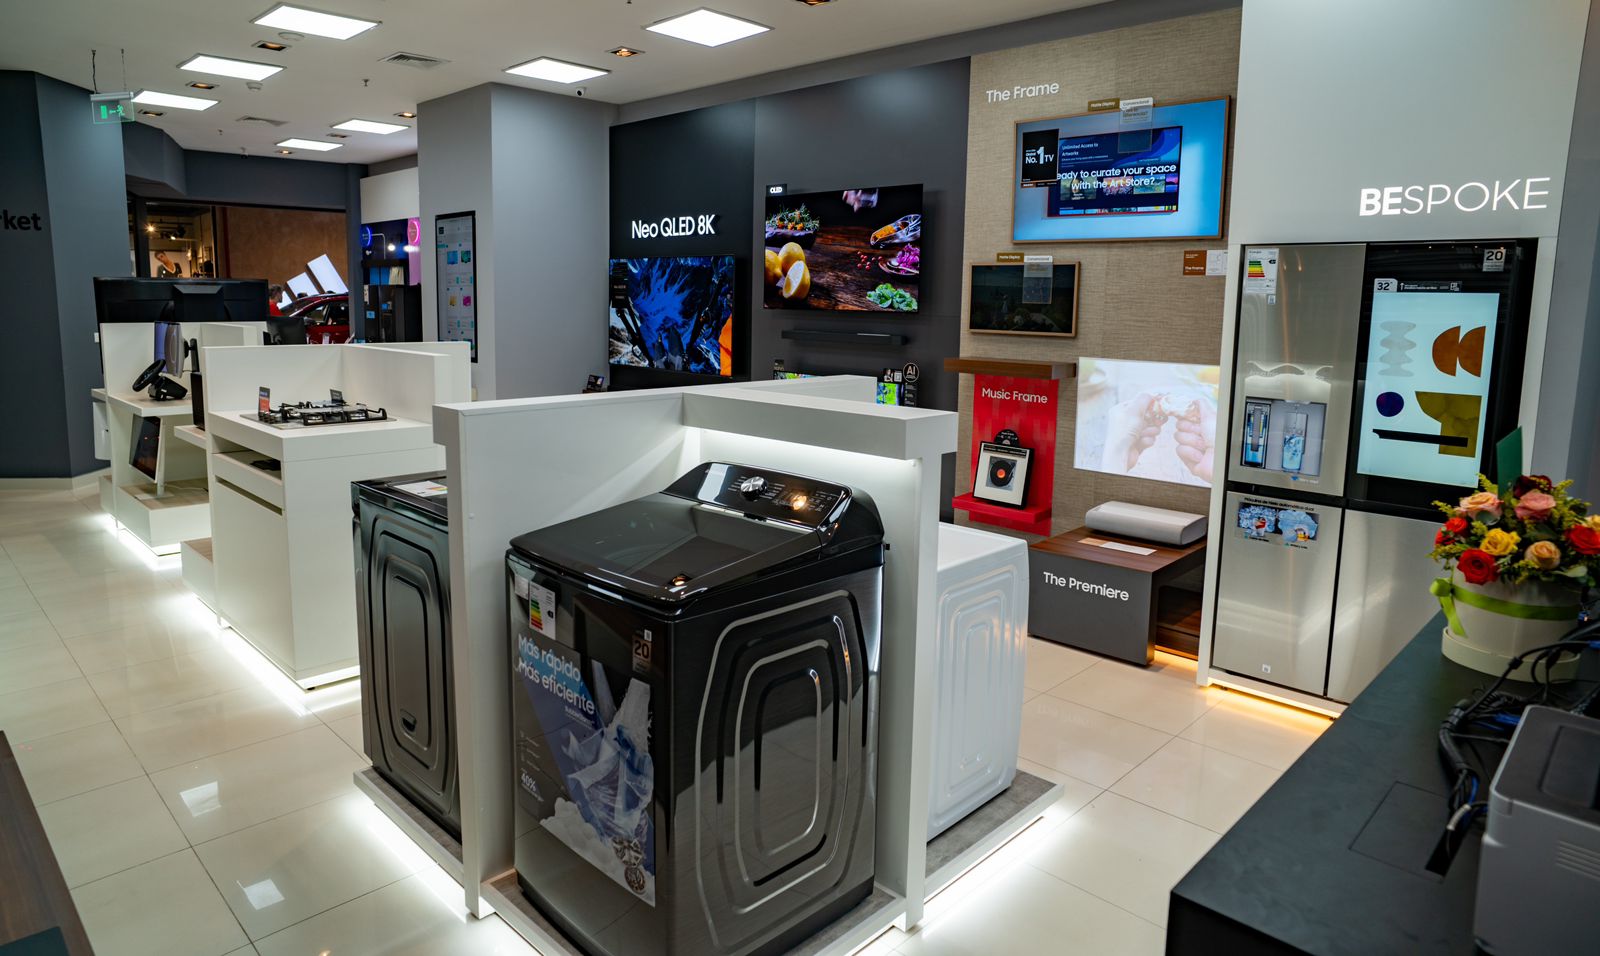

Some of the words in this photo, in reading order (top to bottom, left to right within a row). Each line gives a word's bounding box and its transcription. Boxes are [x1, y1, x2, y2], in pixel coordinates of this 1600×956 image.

[986, 89, 1011, 103] The
[1013, 82, 1060, 99] Frame
[1036, 146, 1045, 165] 1
[1044, 153, 1055, 162] TV
[1057, 170, 1078, 181] eady
[1080, 169, 1089, 178] to
[1090, 167, 1121, 178] curate
[1122, 166, 1144, 178] your
[1145, 164, 1177, 175] space
[1071, 180, 1091, 190] with
[1093, 179, 1108, 188] the
[1109, 178, 1124, 187] Art
[1126, 176, 1155, 186] Store?
[1359, 176, 1551, 217] BESPOKE
[631, 219, 659, 239] Neo
[660, 216, 696, 237] QLED
[697, 213, 716, 235] 8K
[1486, 250, 1504, 261] 20
[906, 365, 916, 375] AI
[981, 387, 1011, 400] Music
[1013, 390, 1048, 404] Frame
[1043, 571, 1067, 587] The
[1069, 577, 1130, 601] Premiere
[518, 632, 540, 660] Más
[634, 639, 650, 659] 20
[518, 656, 540, 684] Más
[541, 674, 595, 715] eficiente
